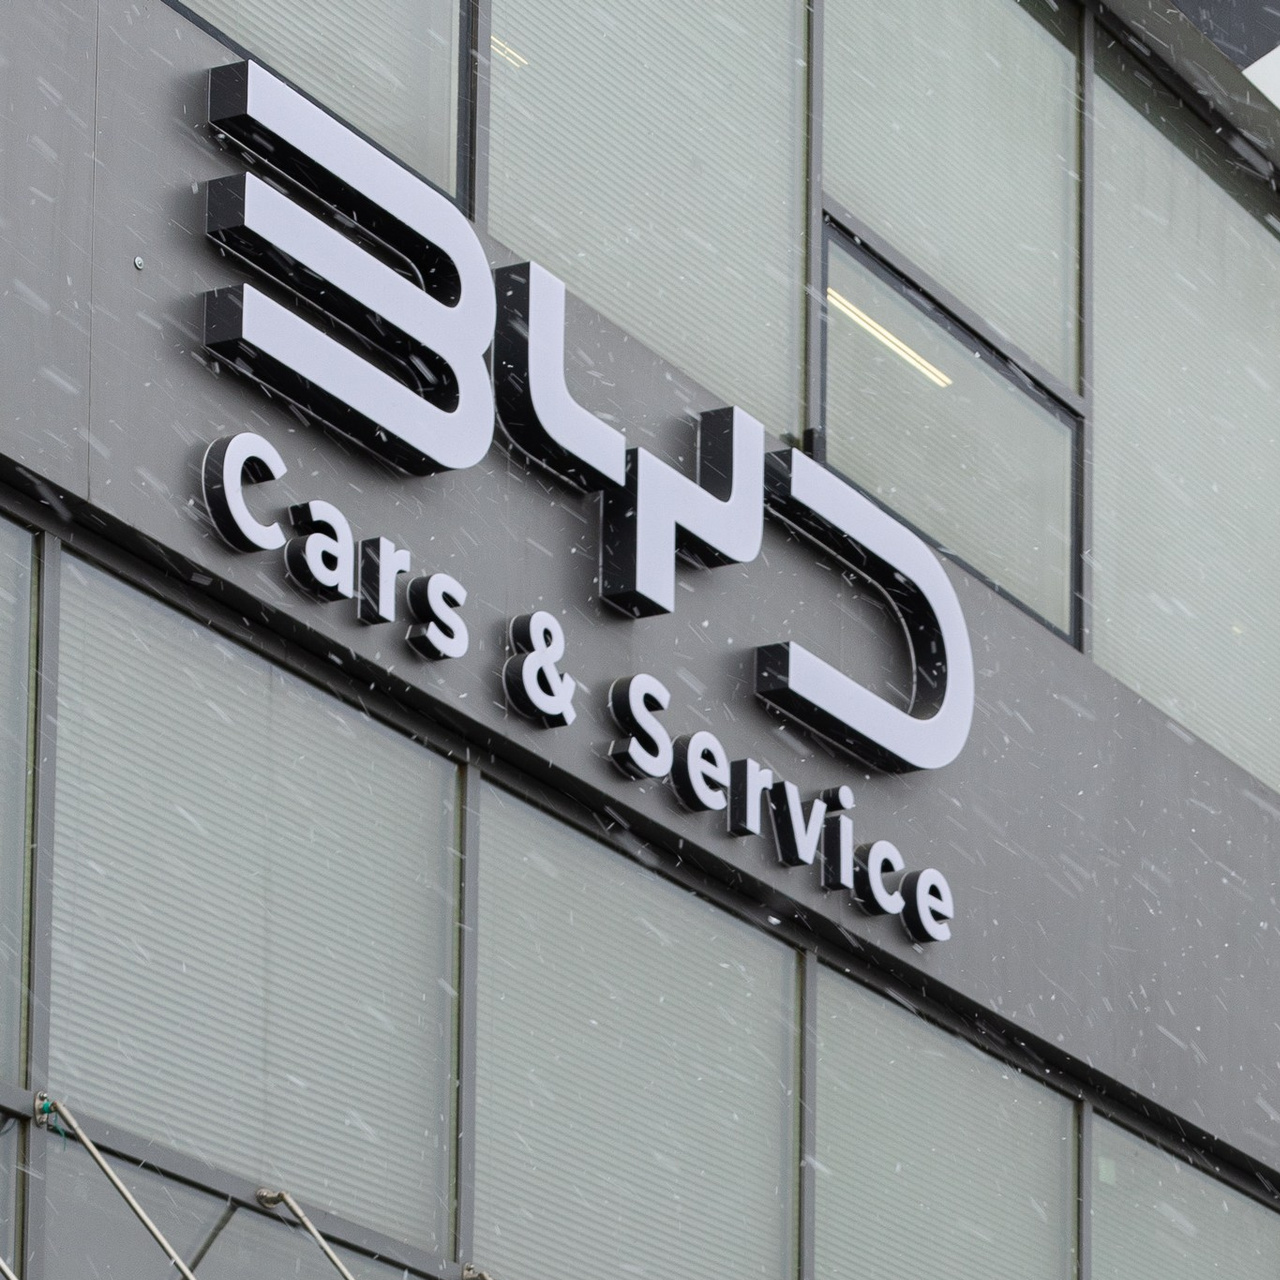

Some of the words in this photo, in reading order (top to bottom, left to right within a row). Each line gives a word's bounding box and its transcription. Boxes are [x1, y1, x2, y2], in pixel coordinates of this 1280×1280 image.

[203, 432, 469, 659] Cars
[504, 611, 576, 727] &
[608, 673, 953, 942] Service
[206, 60, 974, 770] BYD
